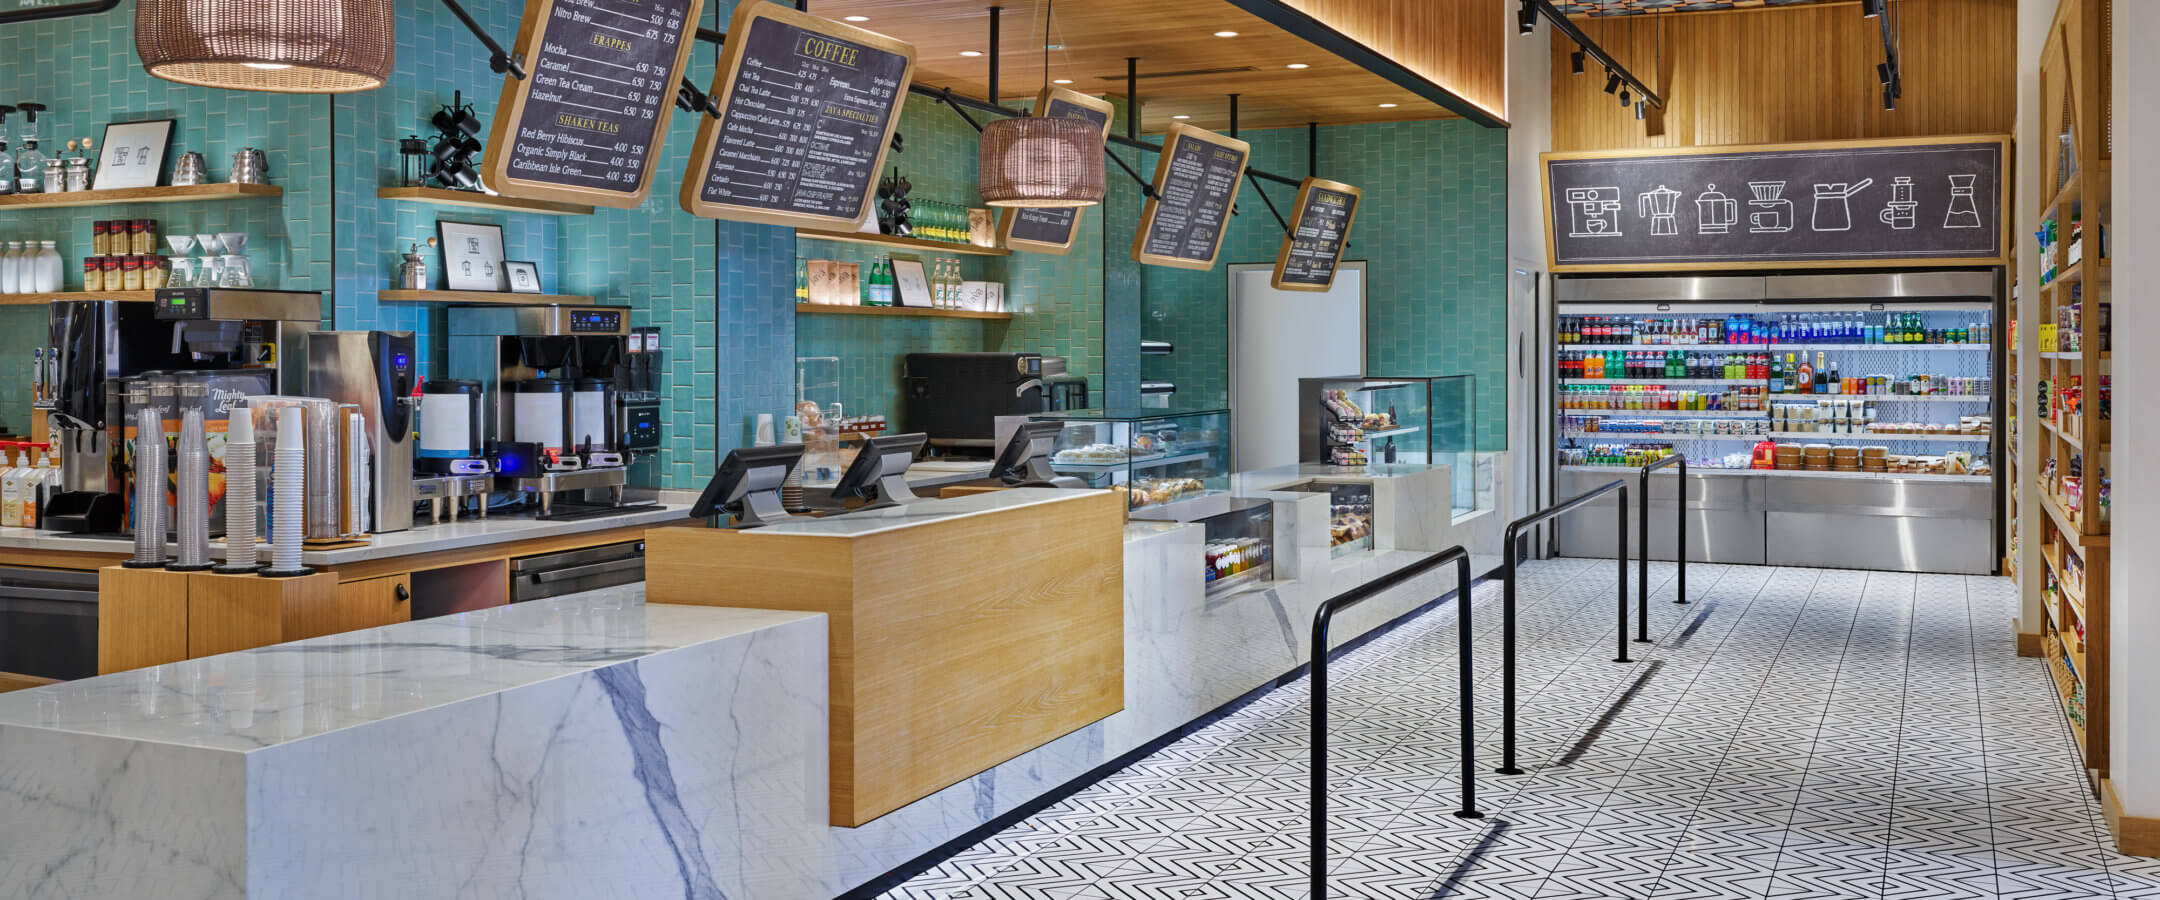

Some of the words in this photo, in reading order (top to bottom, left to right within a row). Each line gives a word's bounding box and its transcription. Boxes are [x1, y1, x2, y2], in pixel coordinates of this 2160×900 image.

[555, 6, 572, 19] Nitro
[573, 11, 591, 24] Brew
[544, 42, 567, 55] Mocha
[593, 34, 631, 50] FRAPPES
[804, 38, 859, 66] COFFEE
[540, 58, 570, 72] Caramel
[747, 57, 762, 67] Coffee
[742, 71, 751, 79] Hot
[752, 72, 760, 81] Tea
[536, 74, 556, 86] Green
[559, 78, 570, 88] Tea
[571, 81, 594, 93] Cream
[739, 84, 750, 92] Chai
[759, 88, 772, 97] Latte
[532, 89, 562, 103] Hazelnut
[735, 97, 744, 105] Hot
[745, 99, 766, 109] Chocolate
[825, 106, 841, 116] JAVA
[559, 114, 595, 130] SHAKEN
[598, 118, 619, 133] TEAS
[521, 128, 536, 139] Red
[537, 130, 555, 143] Berry
[557, 133, 584, 146] Hibiscus
[517, 143, 544, 156] Organic
[545, 147, 568, 160] Simply
[569, 150, 587, 160] Black
[513, 159, 548, 172] Caribbean
[550, 164, 561, 174] Isle
[562, 165, 581, 176] Green
[707, 186, 718, 195] Flat
[718, 187, 732, 196] White
[212, 388, 248, 403] Mighty
